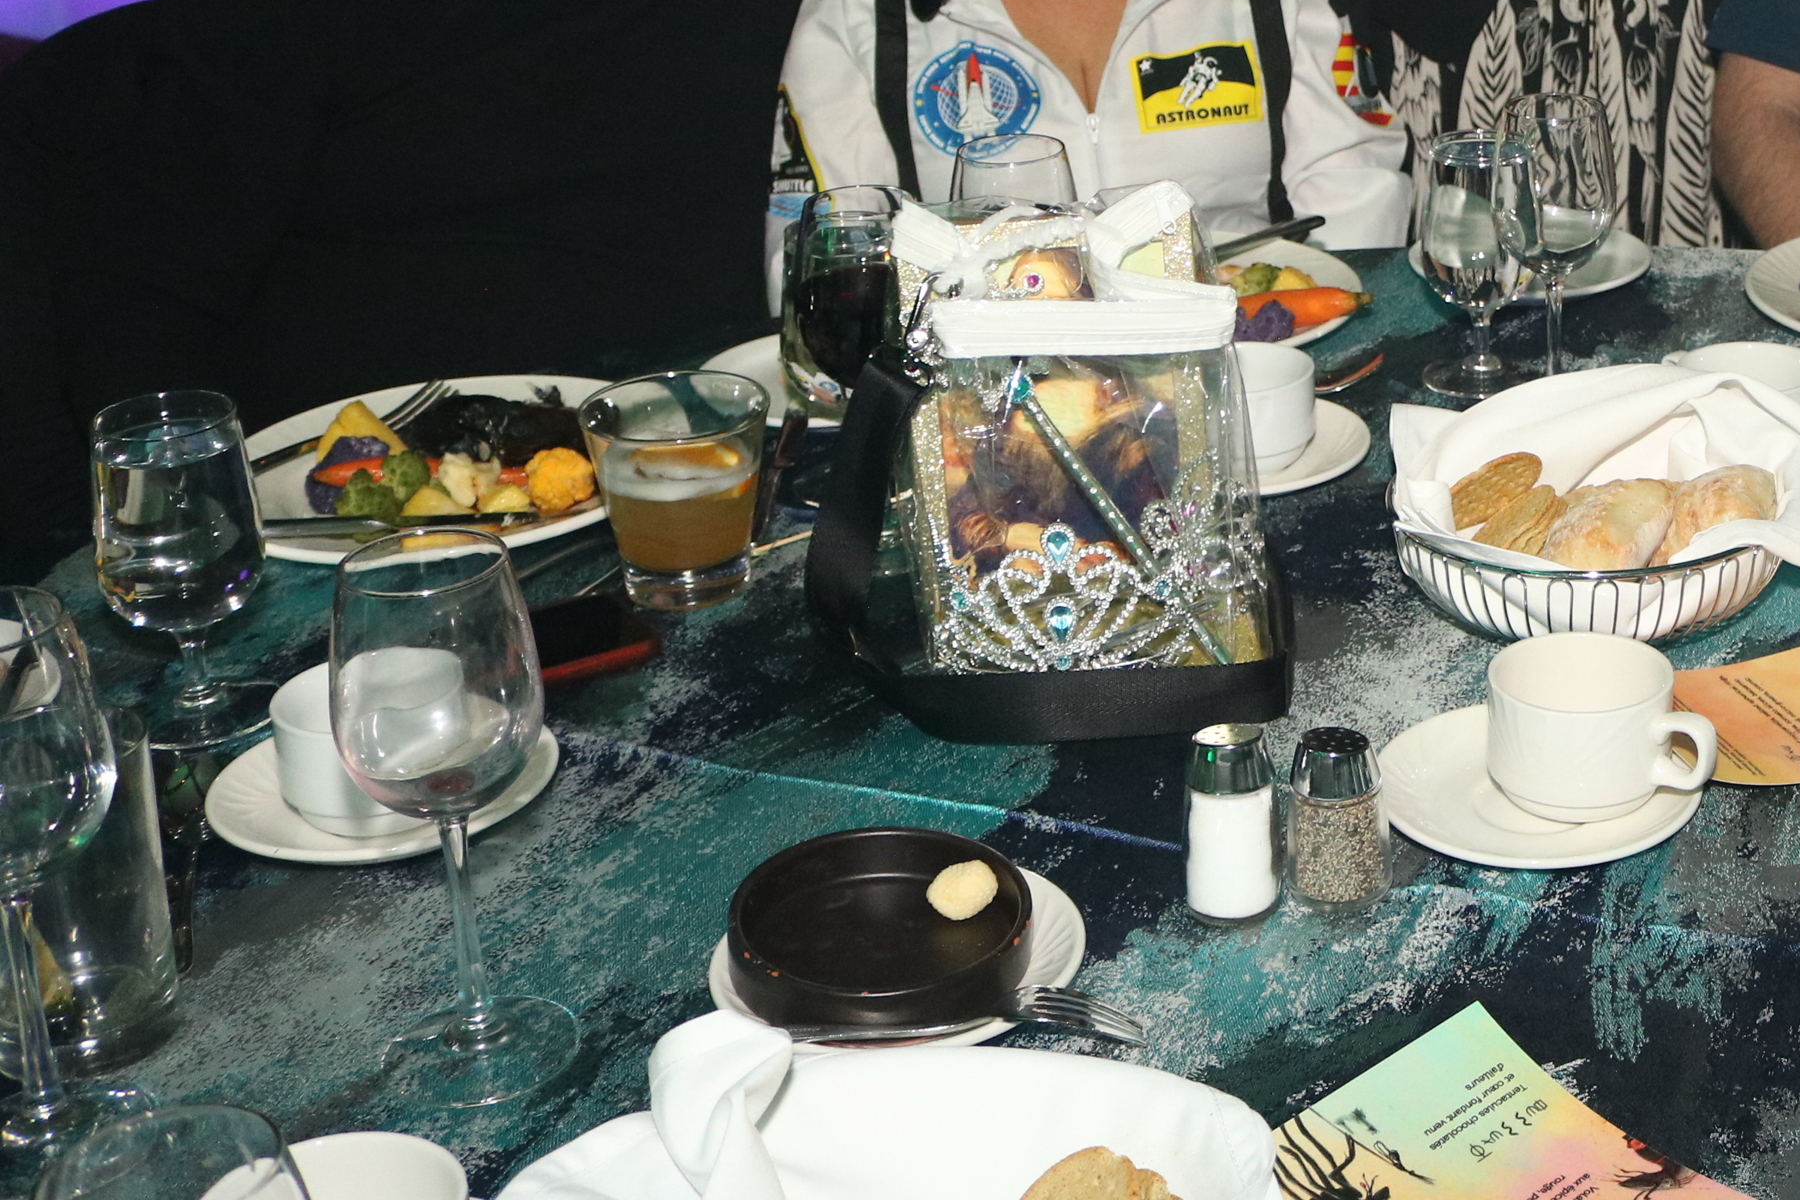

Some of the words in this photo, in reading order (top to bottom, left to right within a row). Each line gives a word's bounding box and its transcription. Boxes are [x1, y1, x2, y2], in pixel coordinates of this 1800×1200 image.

[1156, 104, 1249, 125] ASTRONAUT
[1465, 1063, 1504, 1090] d'ailleurs
[1504, 1074, 1514, 1082] et
[1478, 1084, 1528, 1116] Tentacules
[1482, 1081, 1504, 1098] cœur
[1446, 1096, 1482, 1121] fondant
[1424, 1120, 1447, 1136] venu
[1430, 1116, 1478, 1150] chocolatés
[1574, 1174, 1590, 1186] aux
